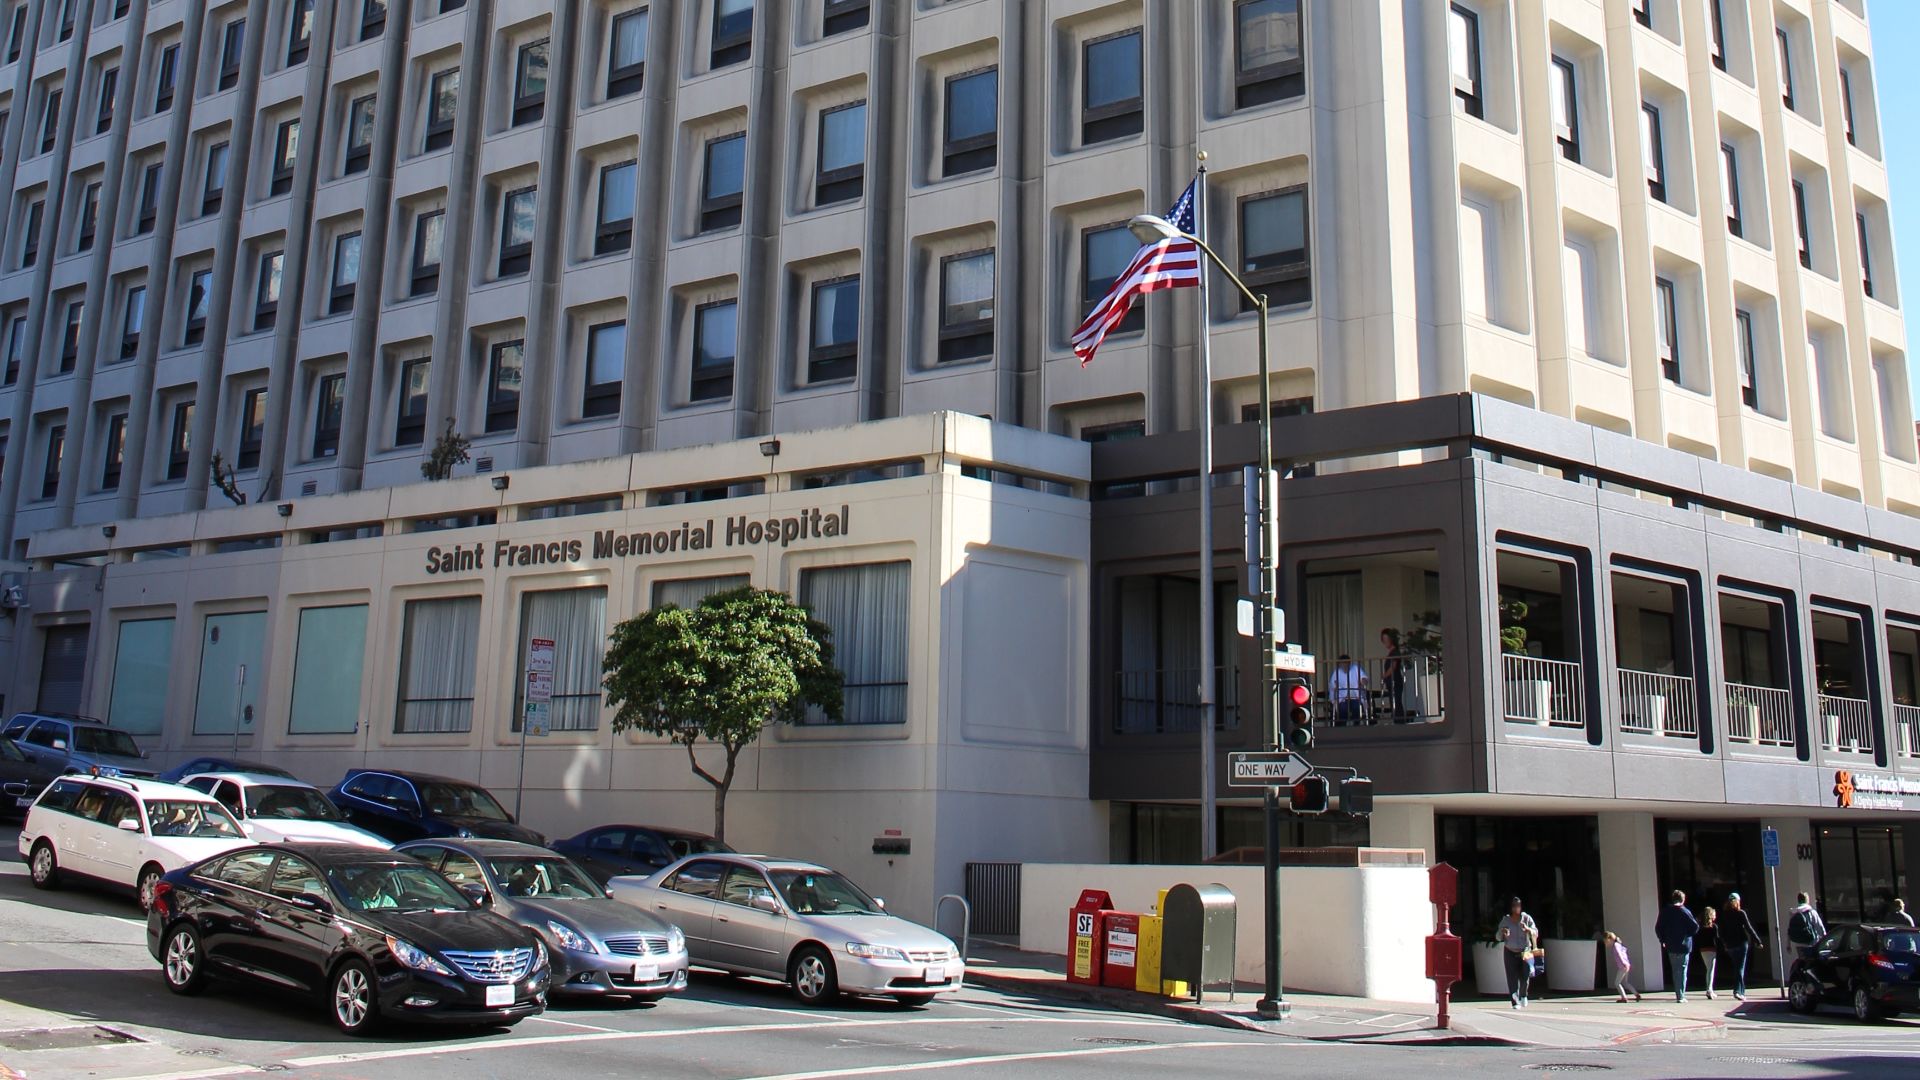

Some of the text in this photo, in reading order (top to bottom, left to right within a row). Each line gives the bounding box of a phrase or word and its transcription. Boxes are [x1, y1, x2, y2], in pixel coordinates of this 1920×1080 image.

[426, 505, 848, 574] Saint Francis Memorial Hospital
[1284, 656, 1306, 667] HYDE
[1238, 764, 1287, 775] ONE WAY
[1855, 773, 1874, 790] Saint
[1874, 775, 1898, 791] Francis
[1797, 843, 1812, 860] 900
[1079, 915, 1091, 932] SF
